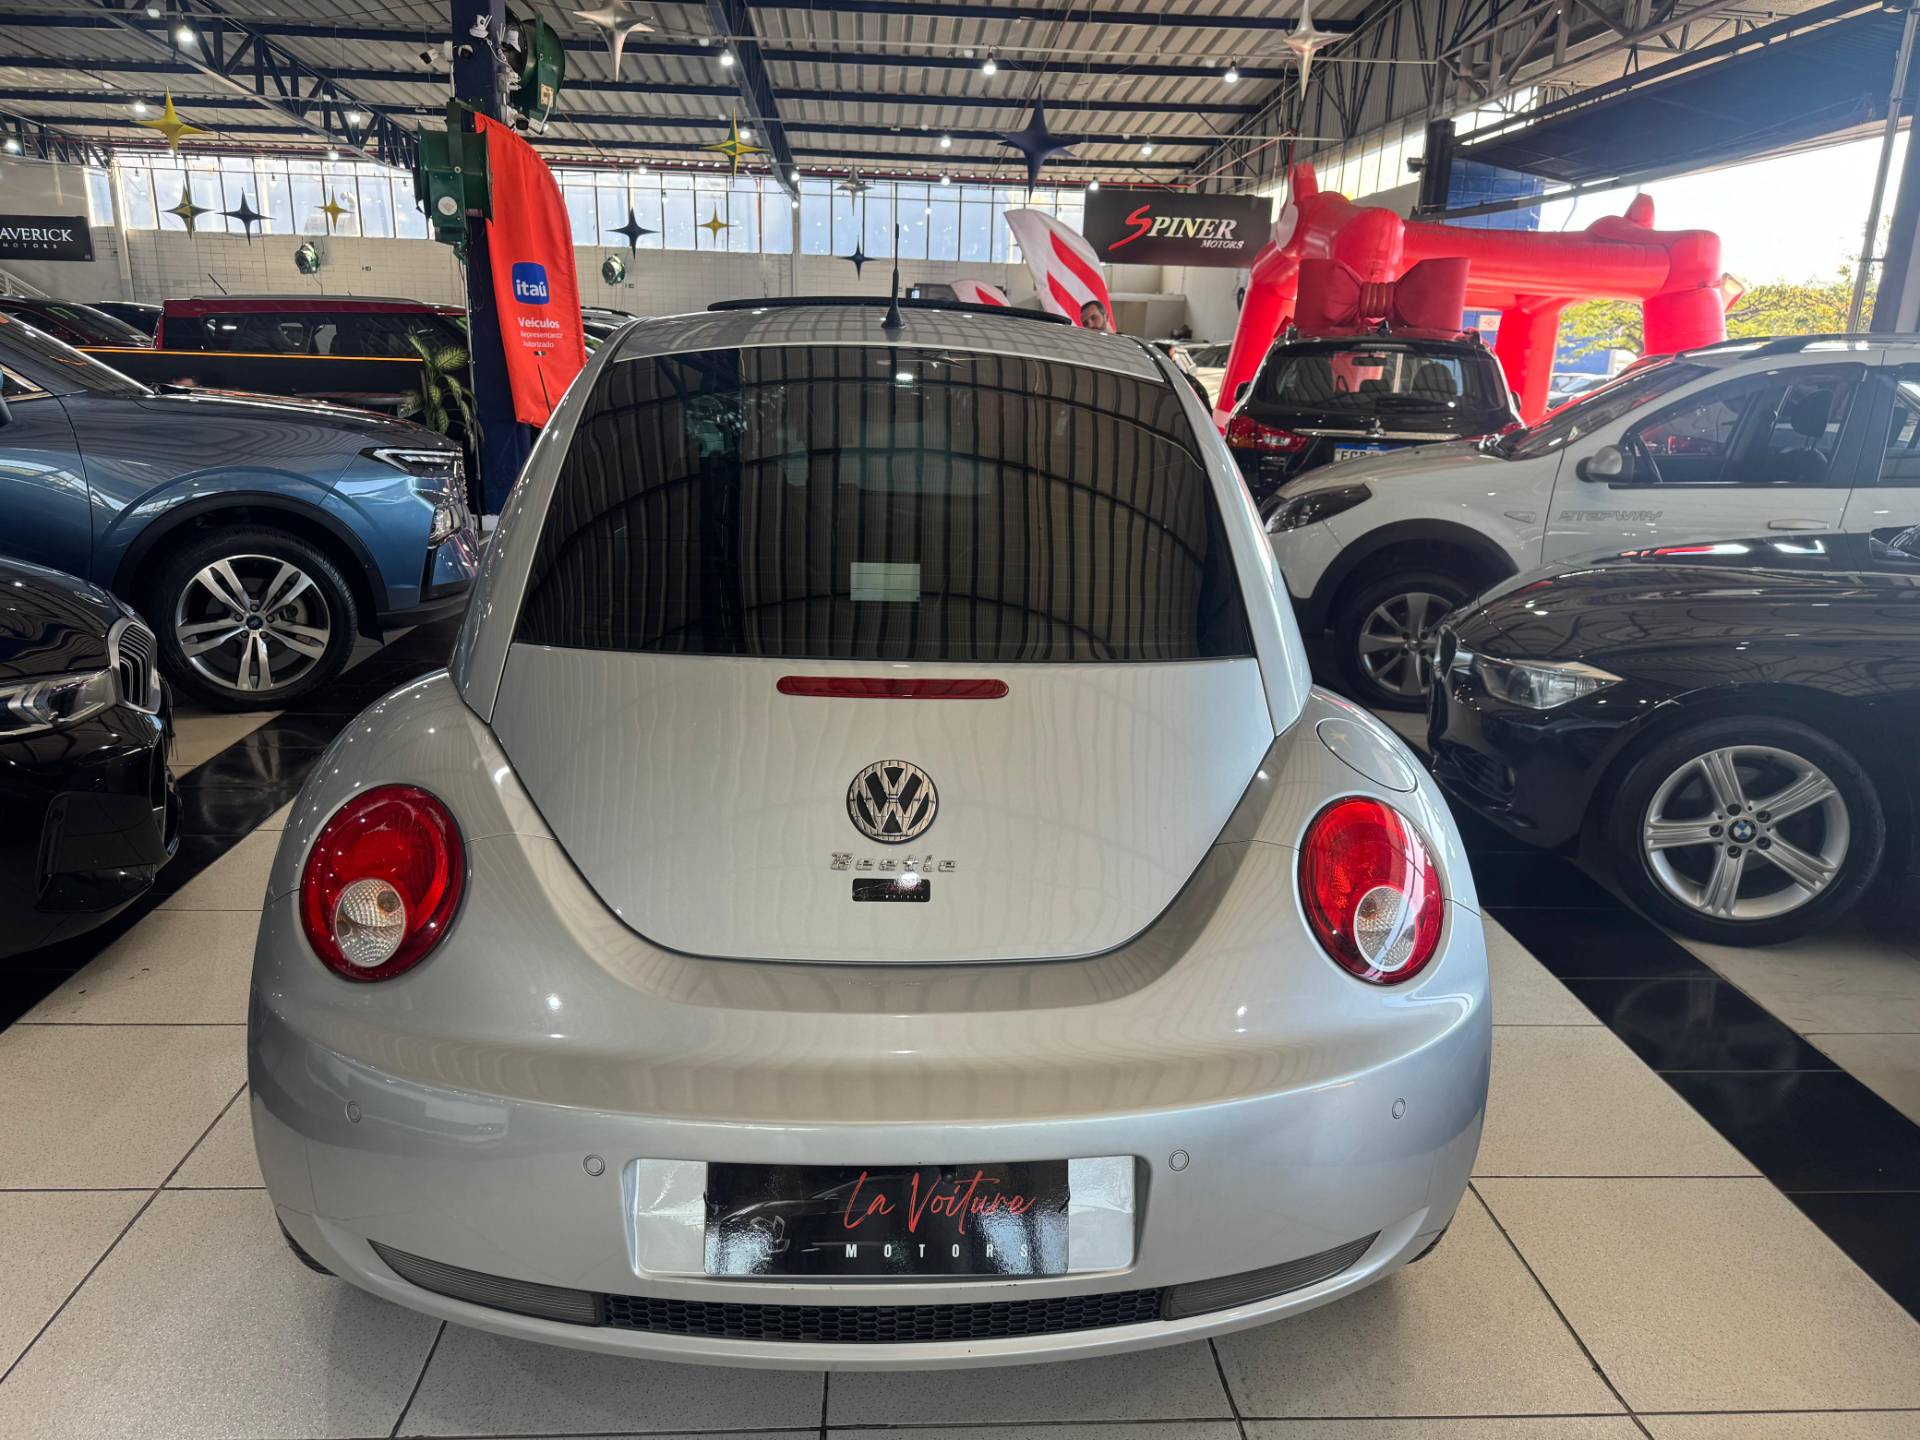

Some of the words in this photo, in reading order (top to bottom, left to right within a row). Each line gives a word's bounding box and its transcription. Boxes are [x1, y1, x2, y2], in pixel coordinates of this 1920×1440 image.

[0, 227, 74, 242] AVERICK
[1108, 203, 1238, 251] SPINER
[1200, 239, 1245, 249] MOTORS
[515, 279, 548, 297] itaú
[1558, 510, 1664, 522] STEPWAY
[830, 852, 958, 873] Beetle
[844, 1170, 897, 1229] La
[908, 1169, 1036, 1236] Voiture
[845, 1243, 1029, 1259] MOTORS
